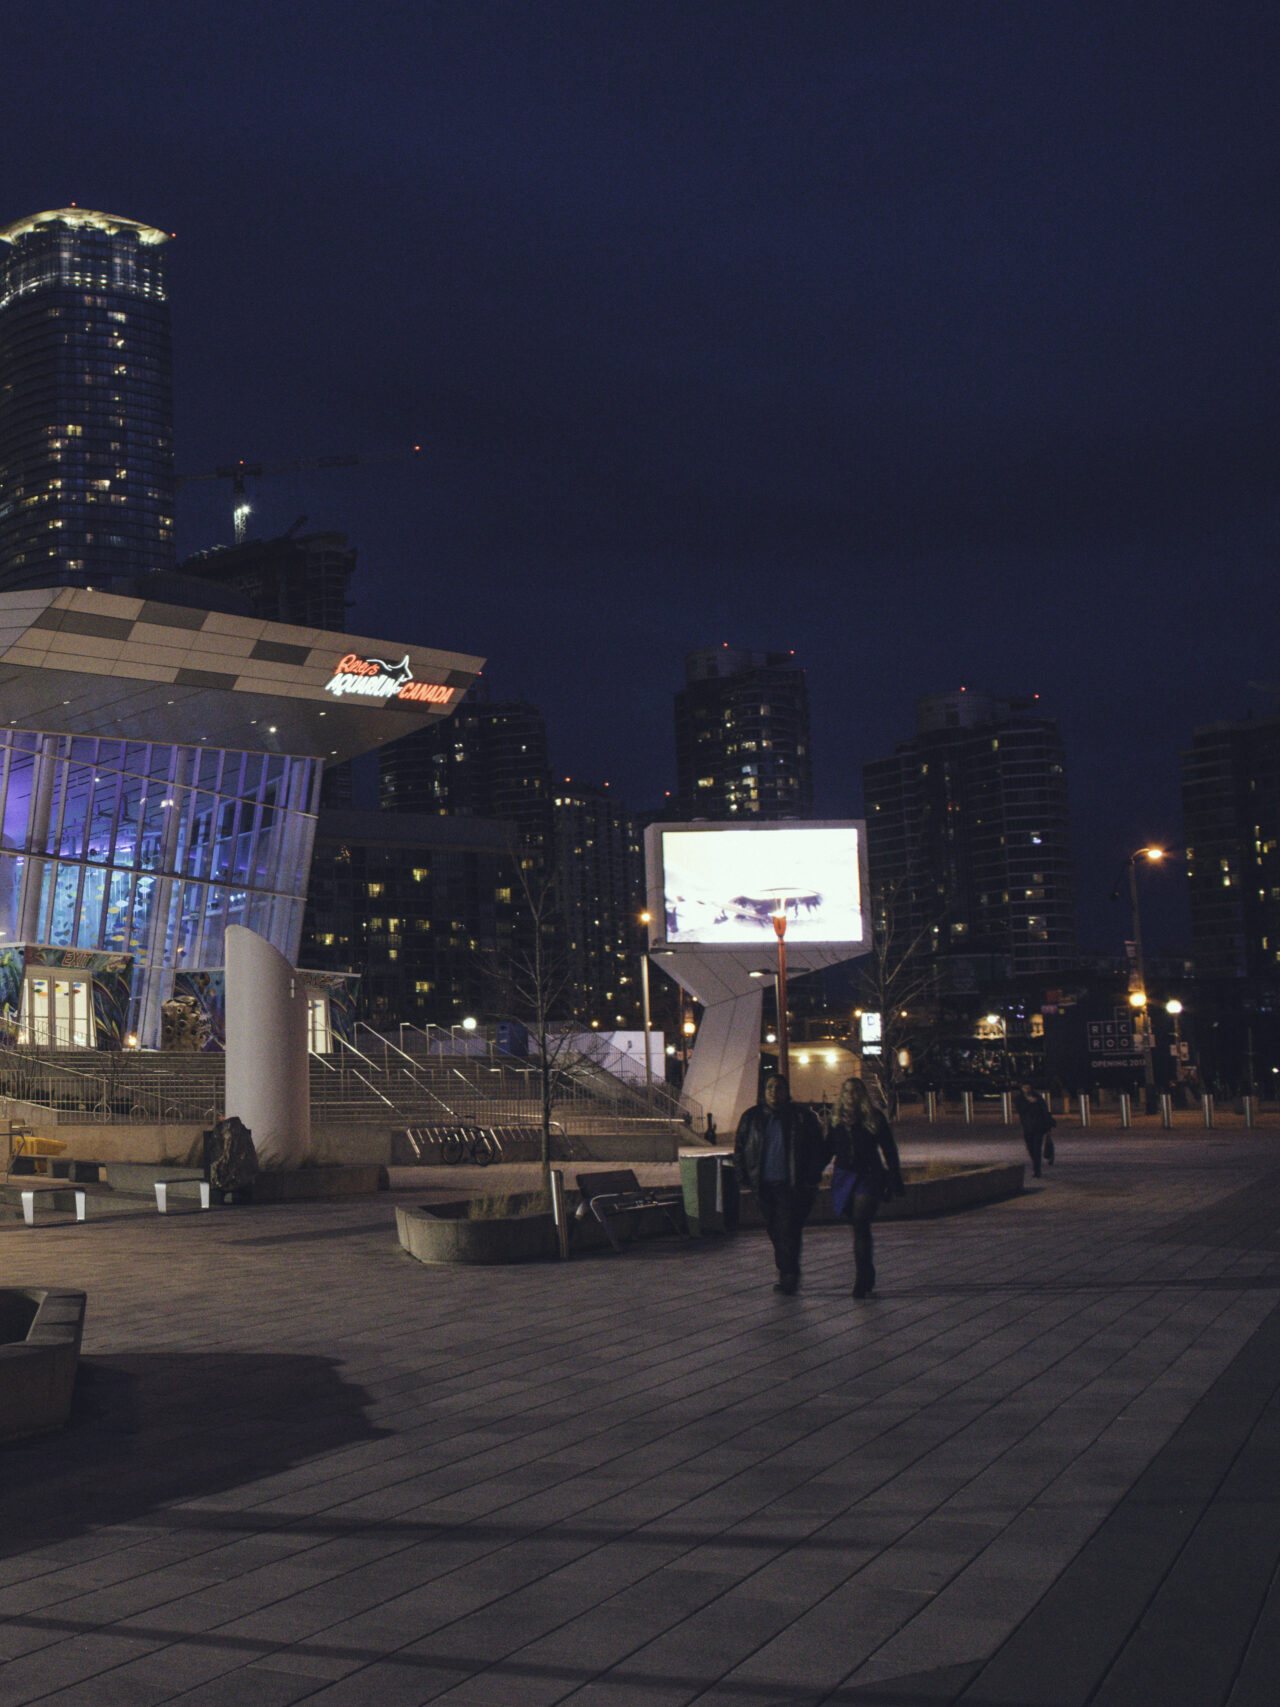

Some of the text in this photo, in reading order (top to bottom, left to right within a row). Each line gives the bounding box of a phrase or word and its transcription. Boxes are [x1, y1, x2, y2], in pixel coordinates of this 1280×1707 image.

[325, 673, 398, 698] AQUARIUM
[398, 682, 456, 704] CANADA
[61, 951, 94, 969] EXIT
[1091, 1024, 1128, 1034] REC
[1092, 1038, 1135, 1048] ROO
[1091, 1059, 1129, 1068] OPENING
